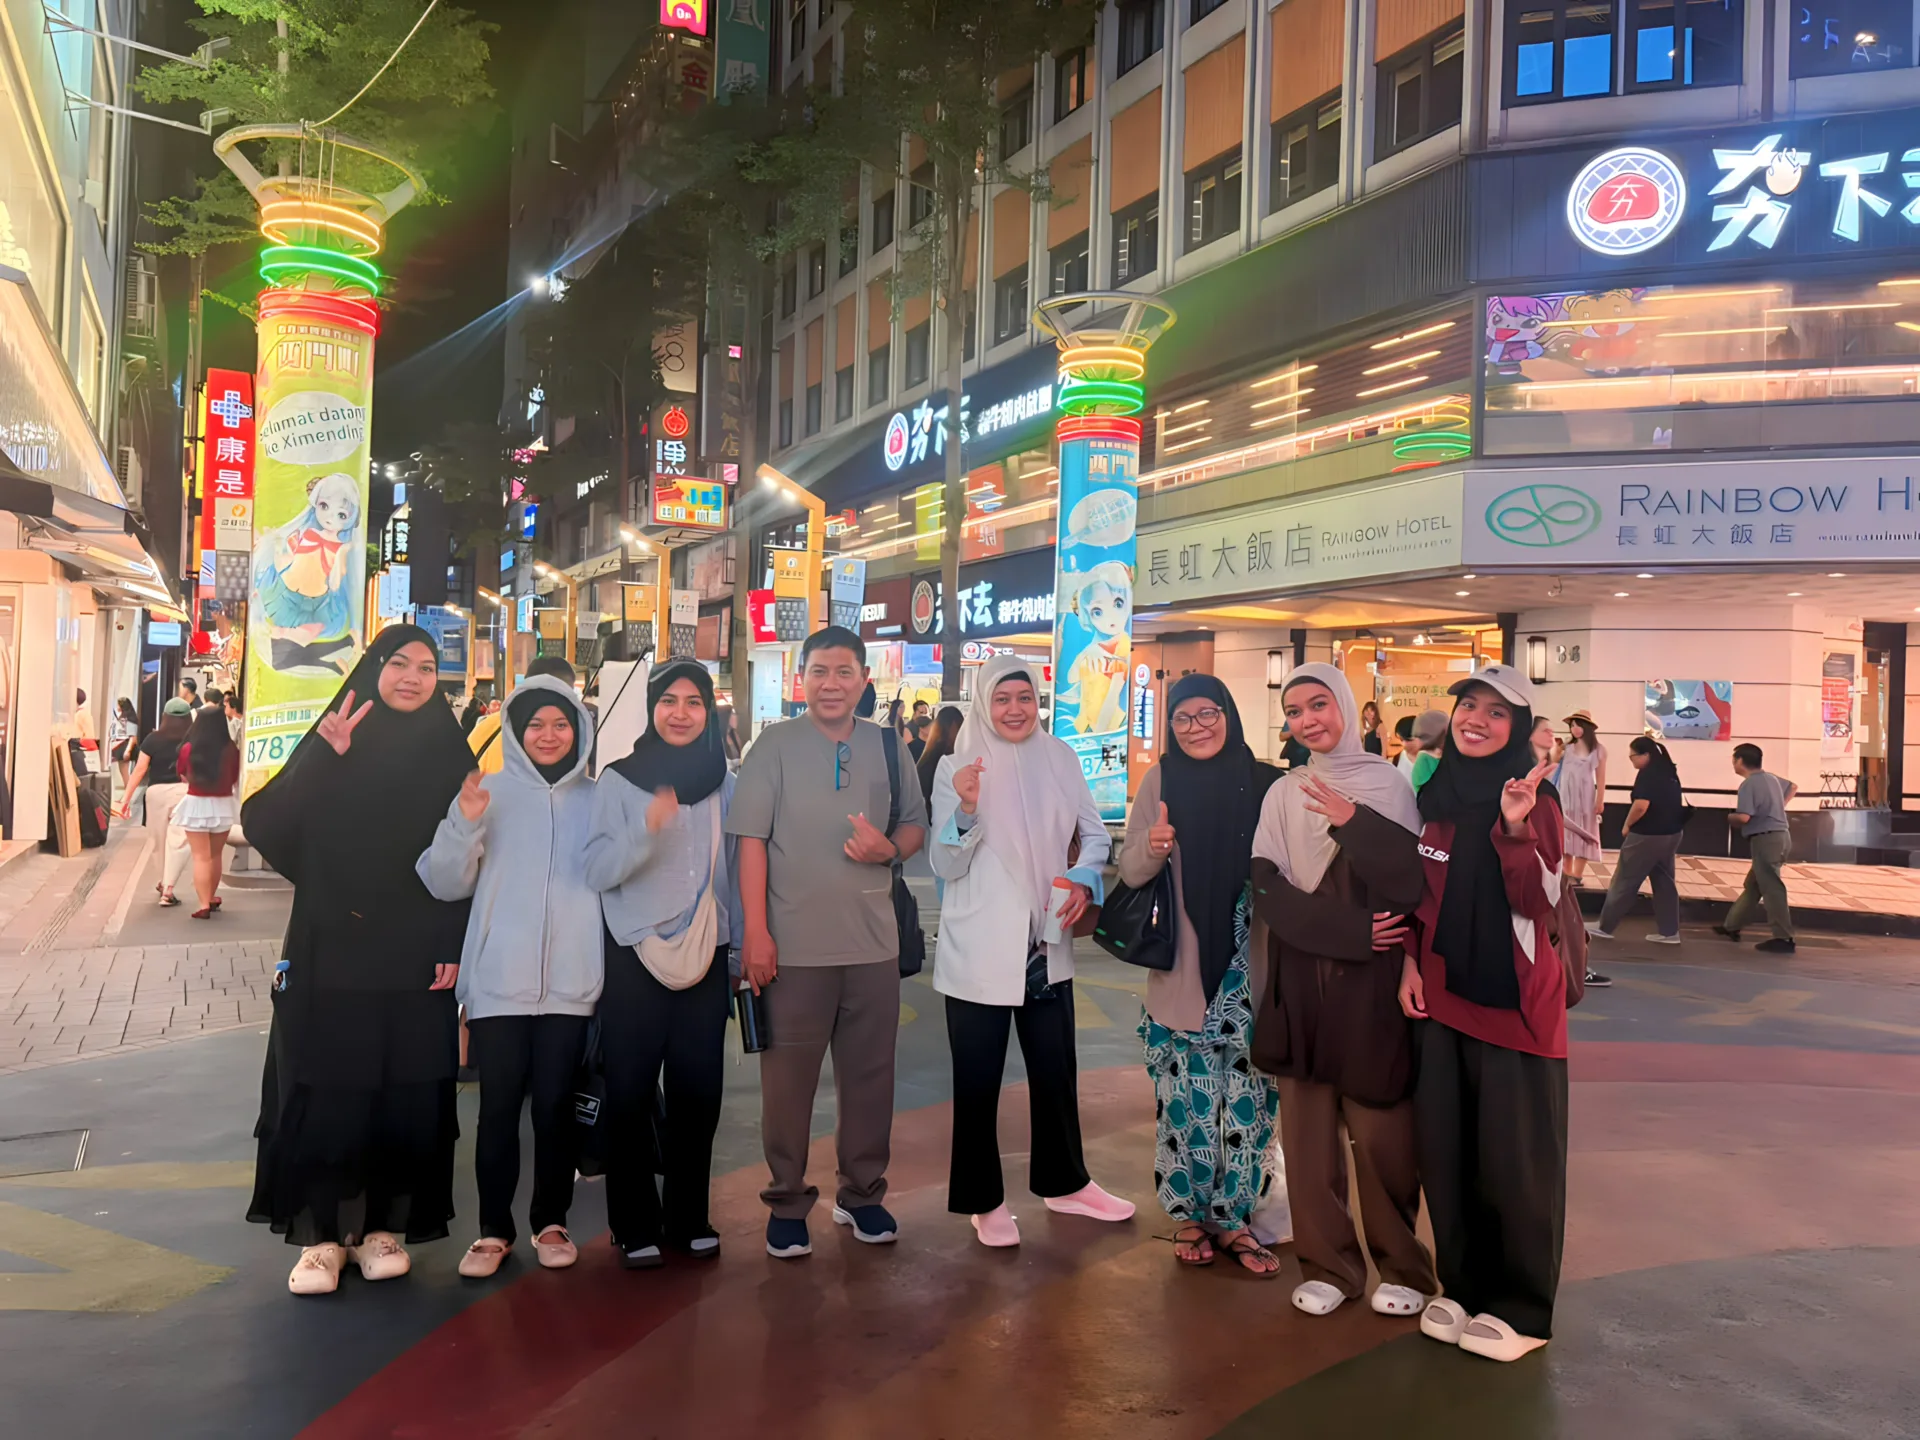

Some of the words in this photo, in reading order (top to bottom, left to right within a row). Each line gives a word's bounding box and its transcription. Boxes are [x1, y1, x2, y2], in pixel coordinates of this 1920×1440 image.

[1605, 178, 1645, 218] 夯
[1620, 483, 1848, 517] RAINBOW
[1878, 476, 1920, 512] H
[1321, 525, 1389, 548] RAINBOW
[1396, 515, 1452, 538] HOTEL
[1615, 522, 1796, 547] 長虹大飯店
[1147, 523, 1313, 587] 長虹大飯店
